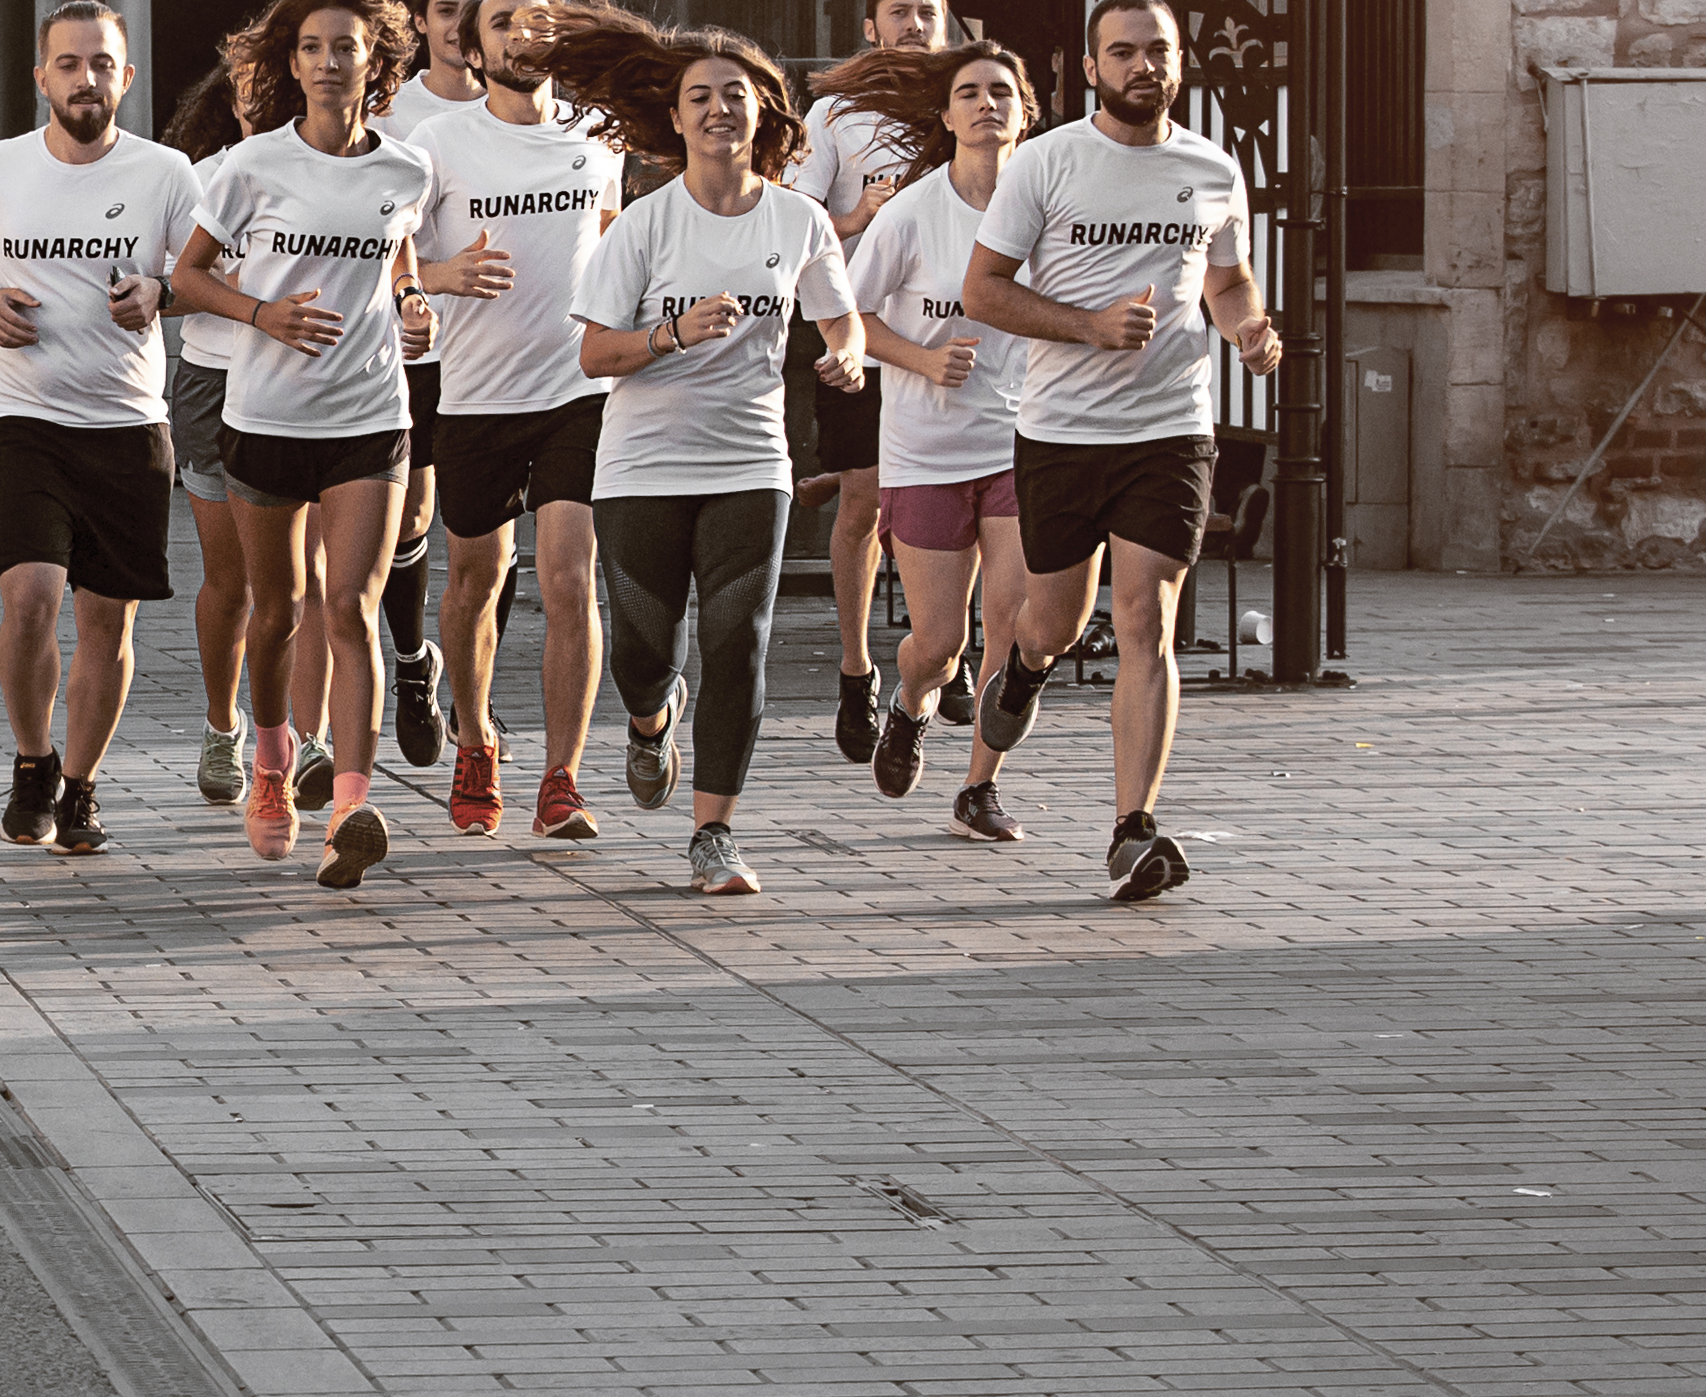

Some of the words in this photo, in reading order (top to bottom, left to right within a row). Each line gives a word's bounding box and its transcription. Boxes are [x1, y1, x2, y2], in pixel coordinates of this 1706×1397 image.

[469, 189, 599, 219] RUNARCHY
[1070, 223, 1209, 246] RUNARCHY
[3, 236, 140, 260] RUNARCHY
